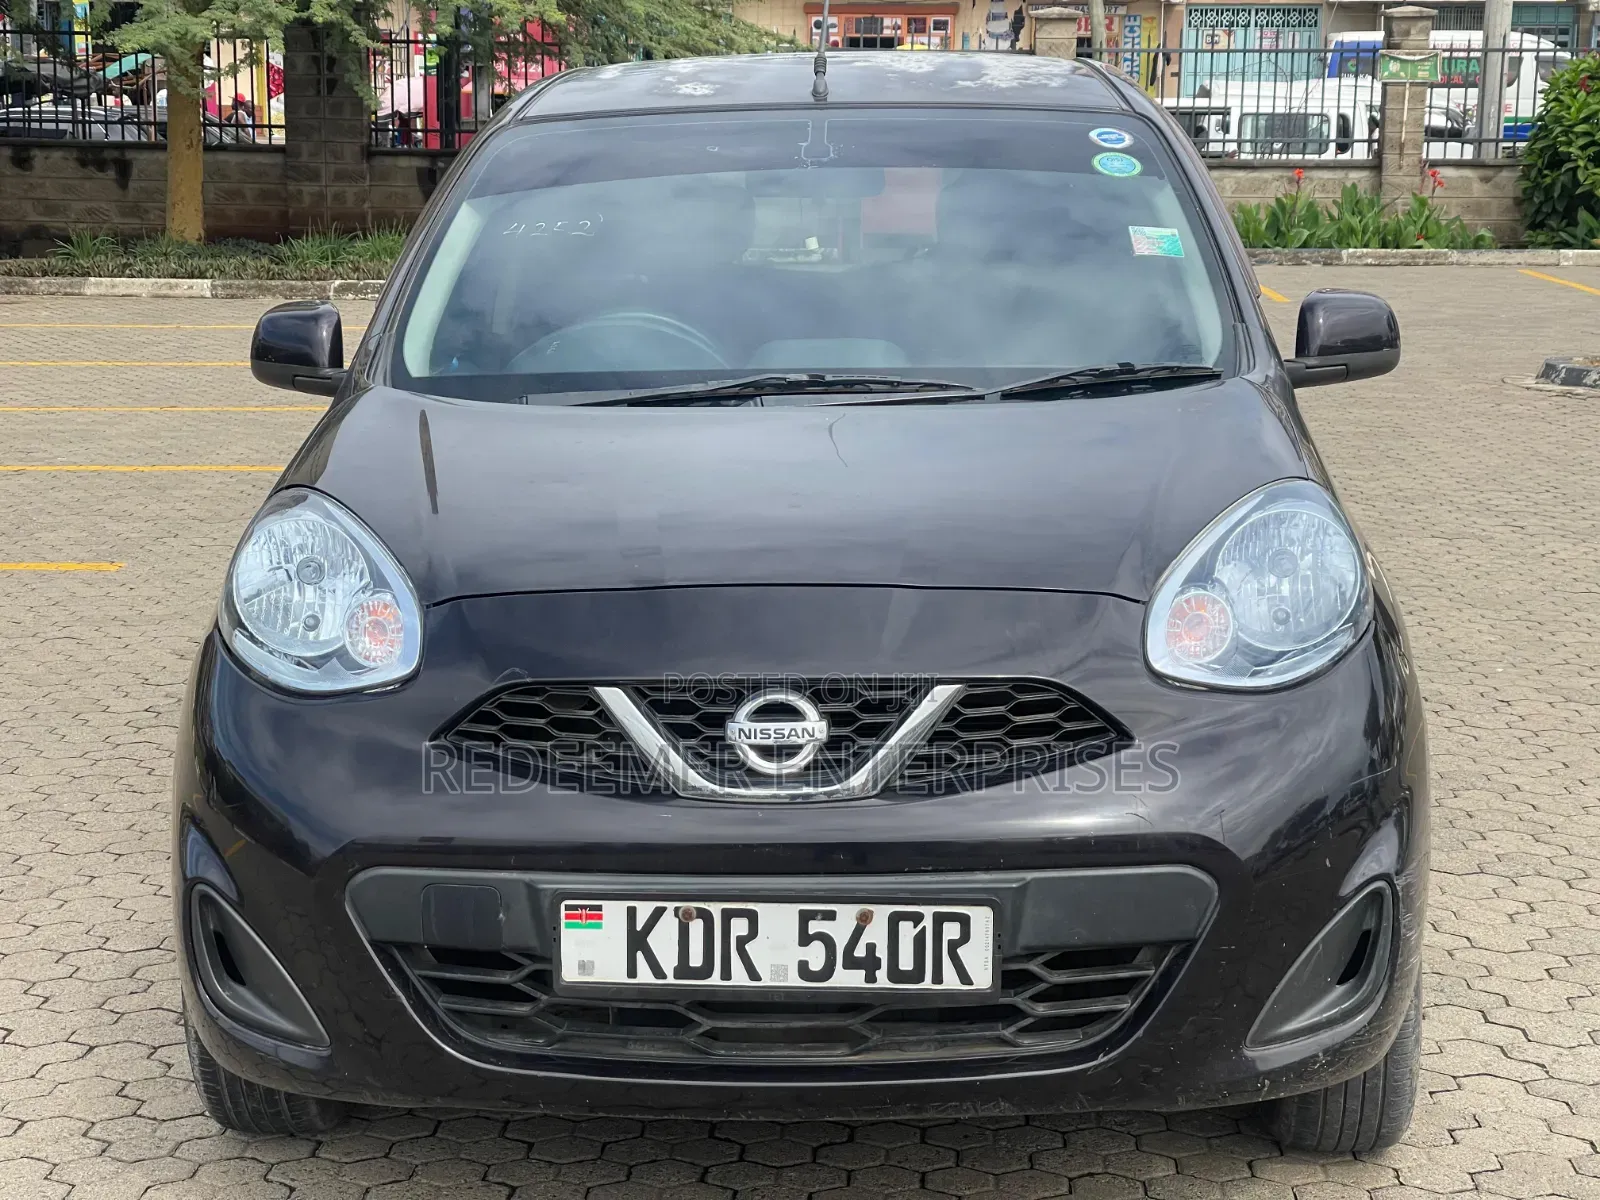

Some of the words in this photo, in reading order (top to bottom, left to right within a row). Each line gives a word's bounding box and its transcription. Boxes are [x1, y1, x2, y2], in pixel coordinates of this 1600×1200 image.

[737, 727, 816, 740] NISSAN
[626, 905, 763, 982] KDR
[798, 909, 975, 986] 540R
